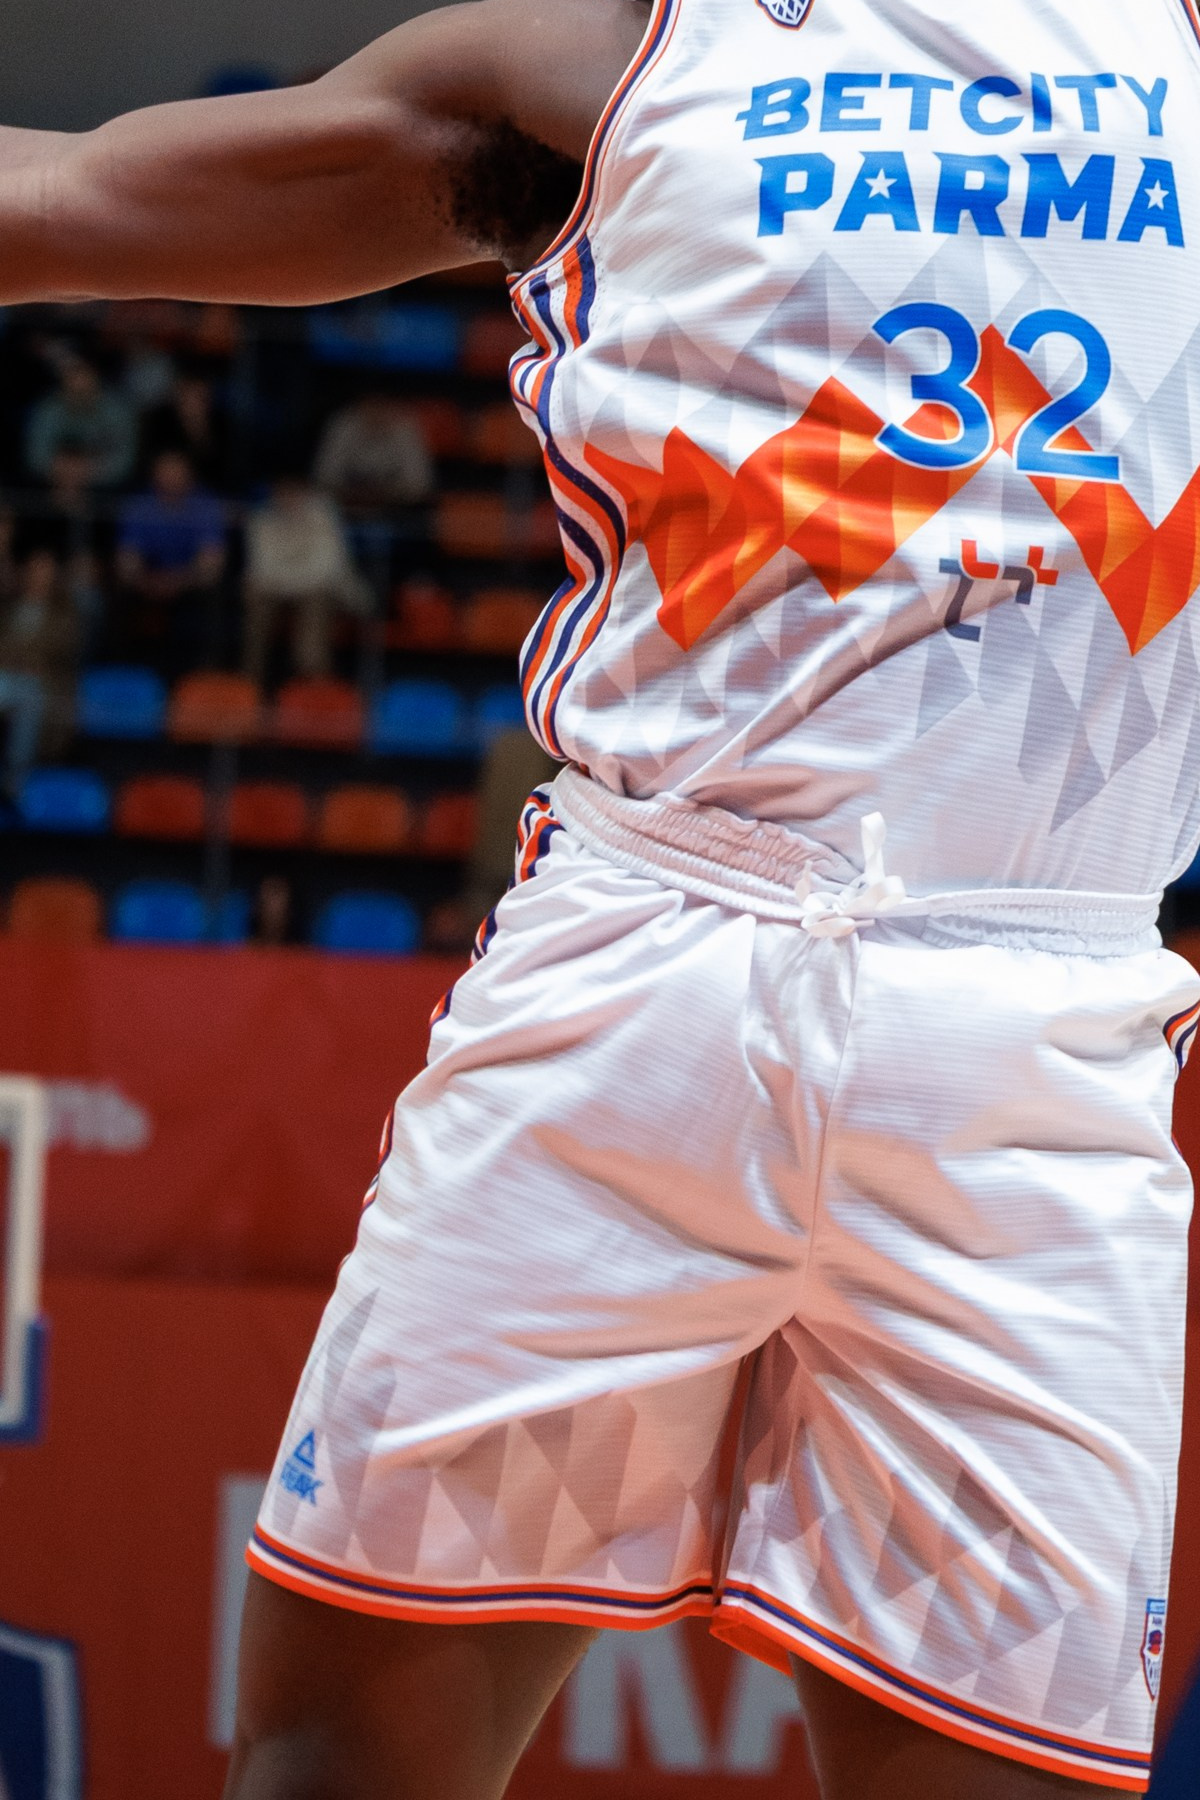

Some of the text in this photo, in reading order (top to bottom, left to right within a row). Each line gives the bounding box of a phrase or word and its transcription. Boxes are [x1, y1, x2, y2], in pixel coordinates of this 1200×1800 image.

[736, 72, 1168, 142] BETCITY
[753, 151, 1186, 249] PARMA
[872, 301, 1123, 482] 32
